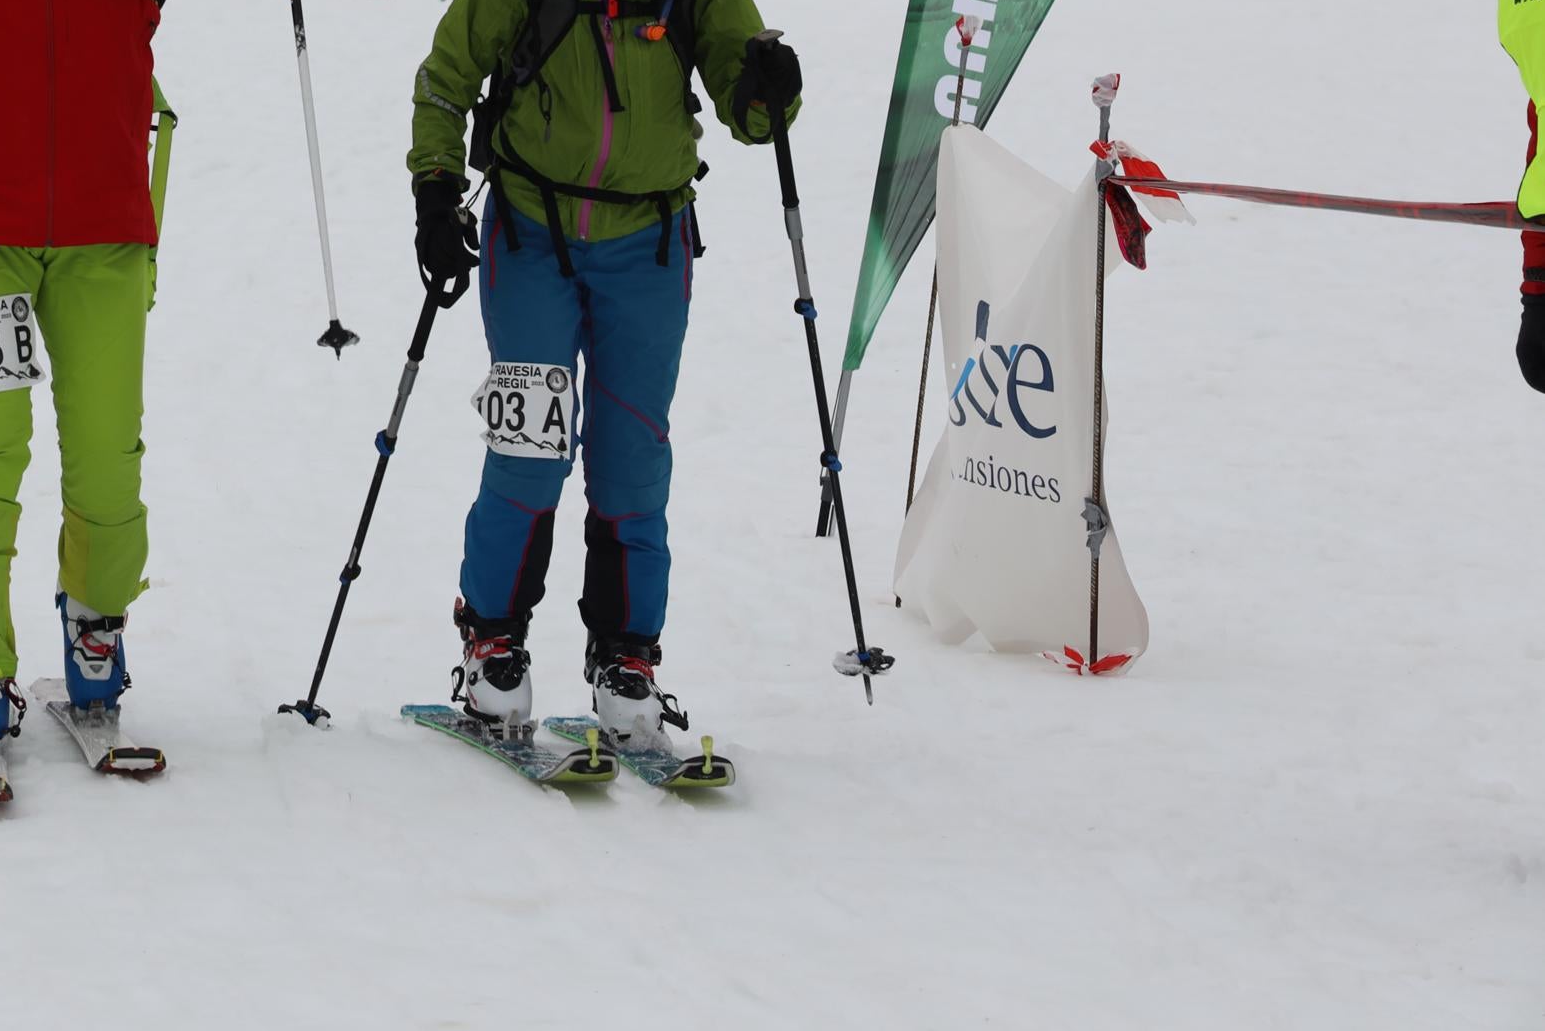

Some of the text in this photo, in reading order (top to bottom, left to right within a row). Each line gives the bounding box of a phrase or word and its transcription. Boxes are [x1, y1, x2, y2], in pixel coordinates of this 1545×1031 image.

[14, 325, 33, 364] B
[497, 377, 531, 389] REGIL
[542, 395, 567, 435] A
[958, 454, 1061, 504] nsiones
